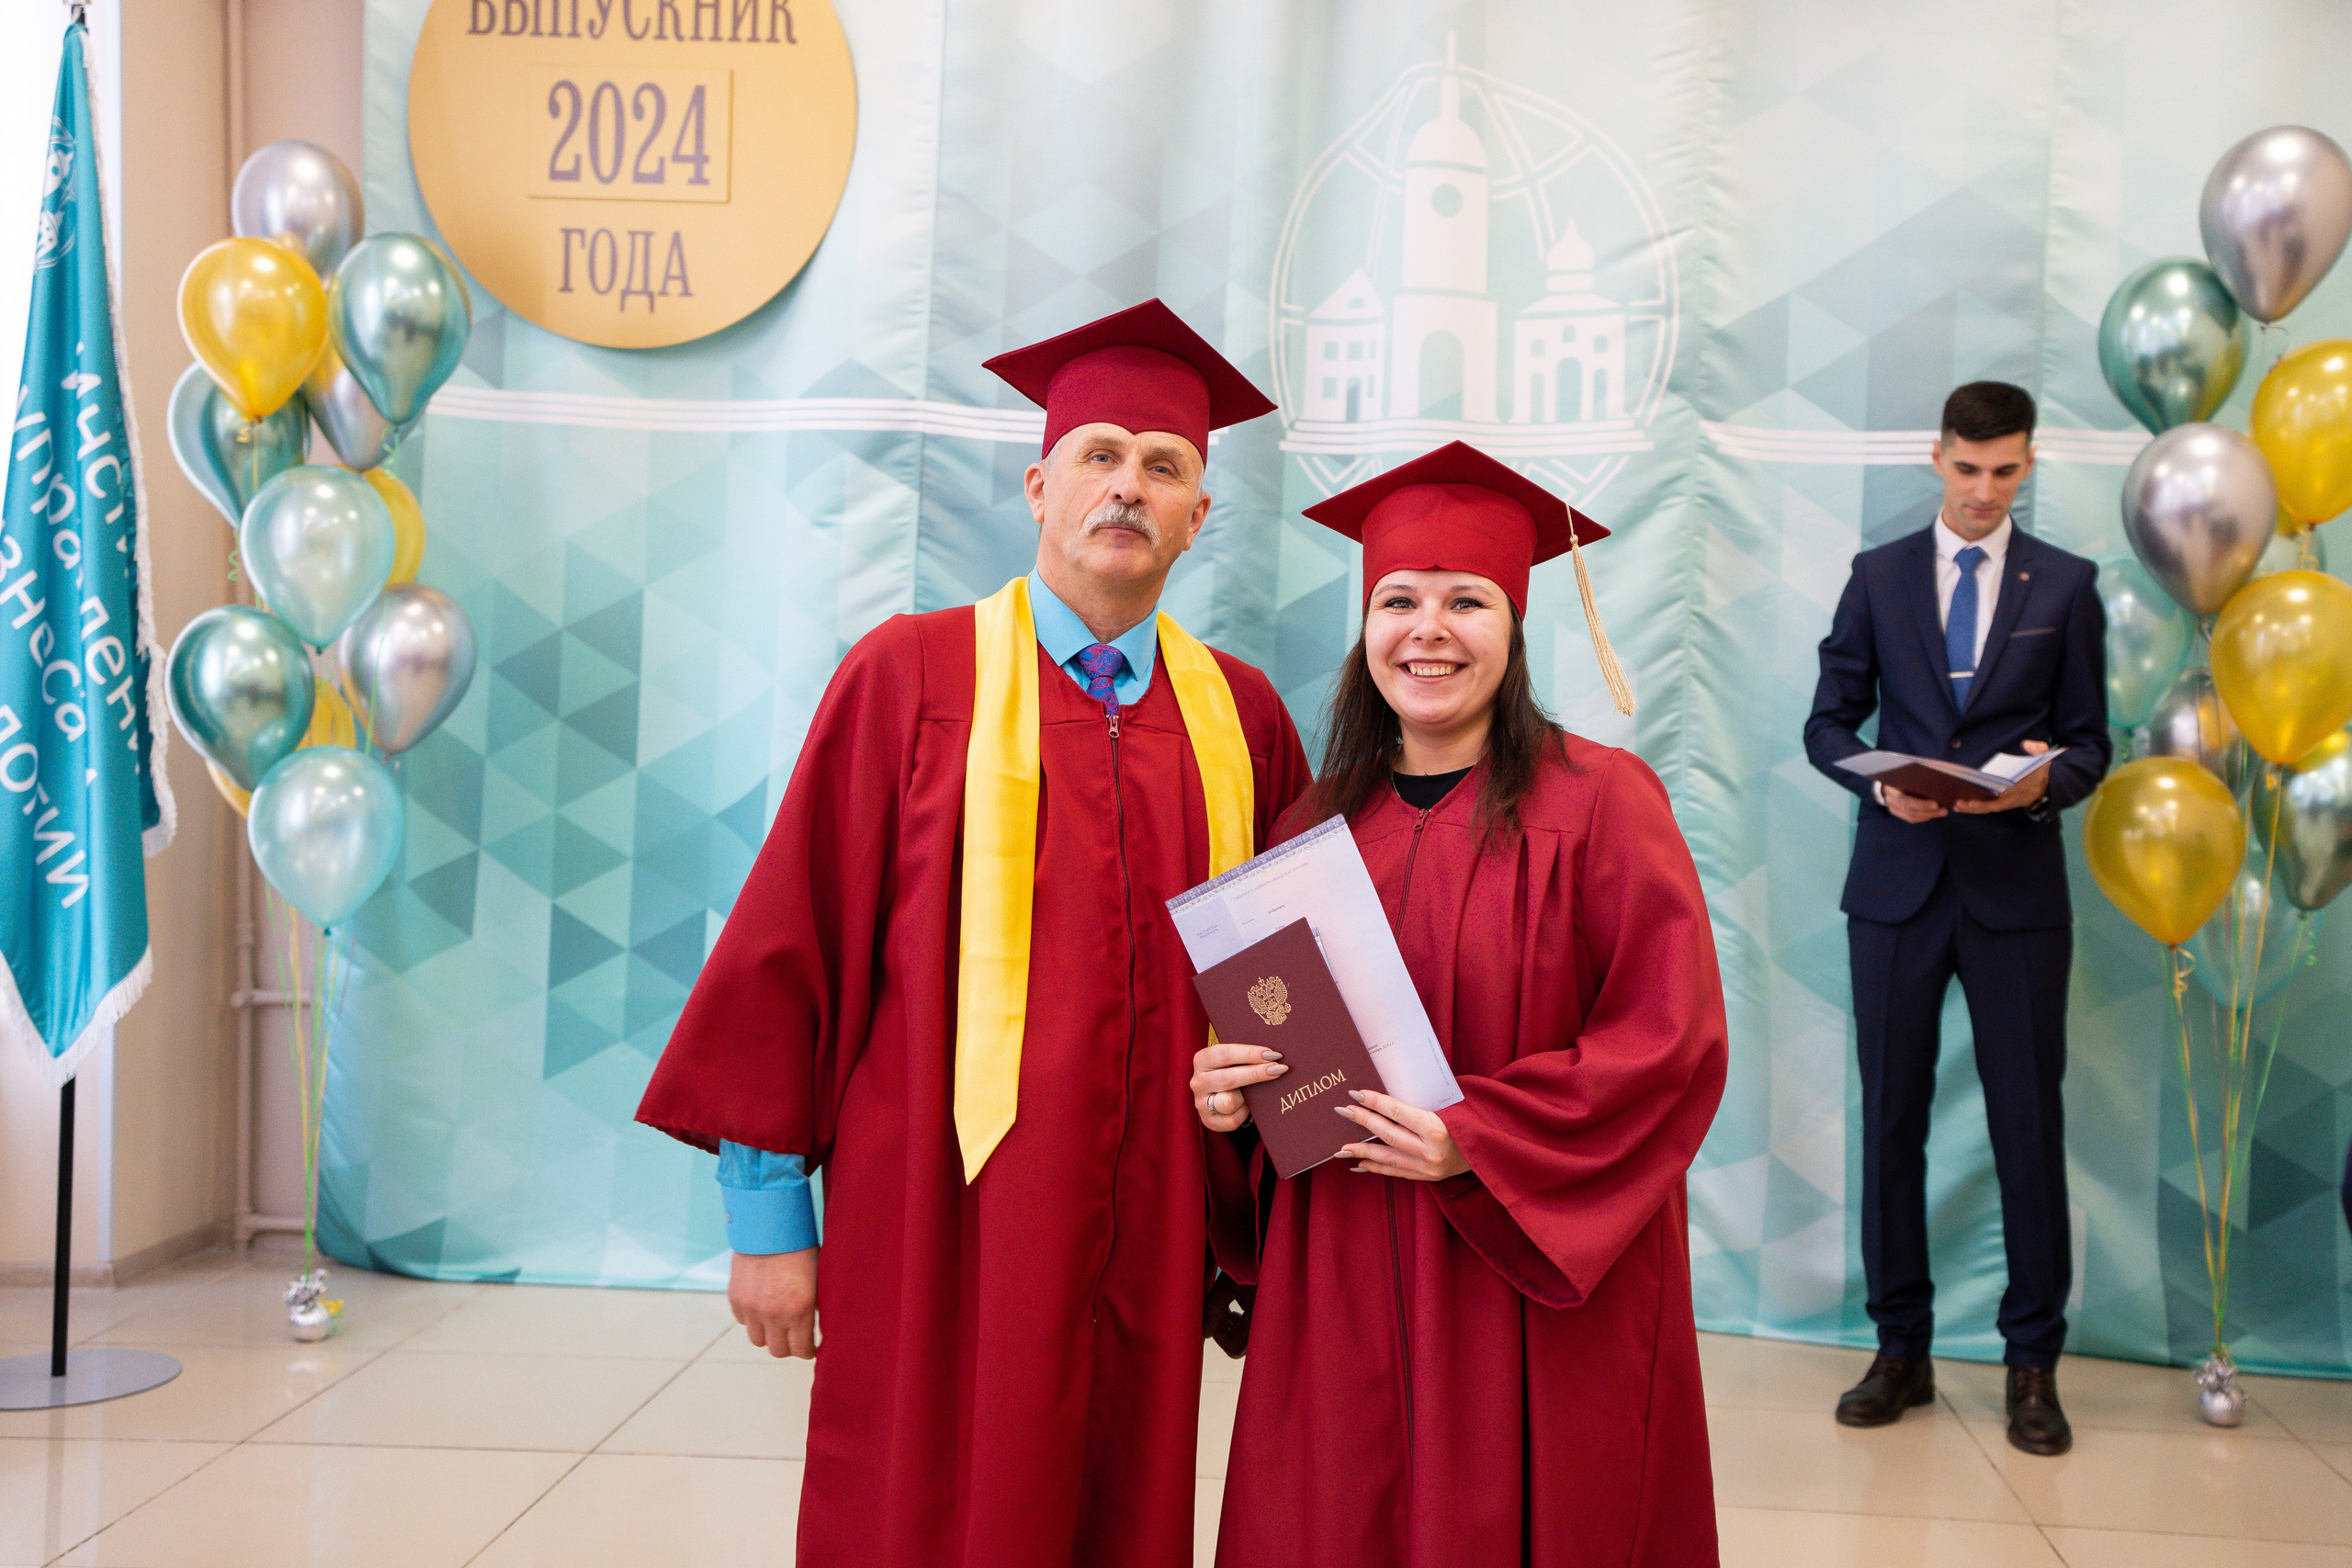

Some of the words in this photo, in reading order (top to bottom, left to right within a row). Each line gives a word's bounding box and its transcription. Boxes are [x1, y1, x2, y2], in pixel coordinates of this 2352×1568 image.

[548, 79, 711, 186] 2024
[559, 228, 695, 313] ГОДА
[1280, 1068, 1347, 1115] ДИПЛОМ
